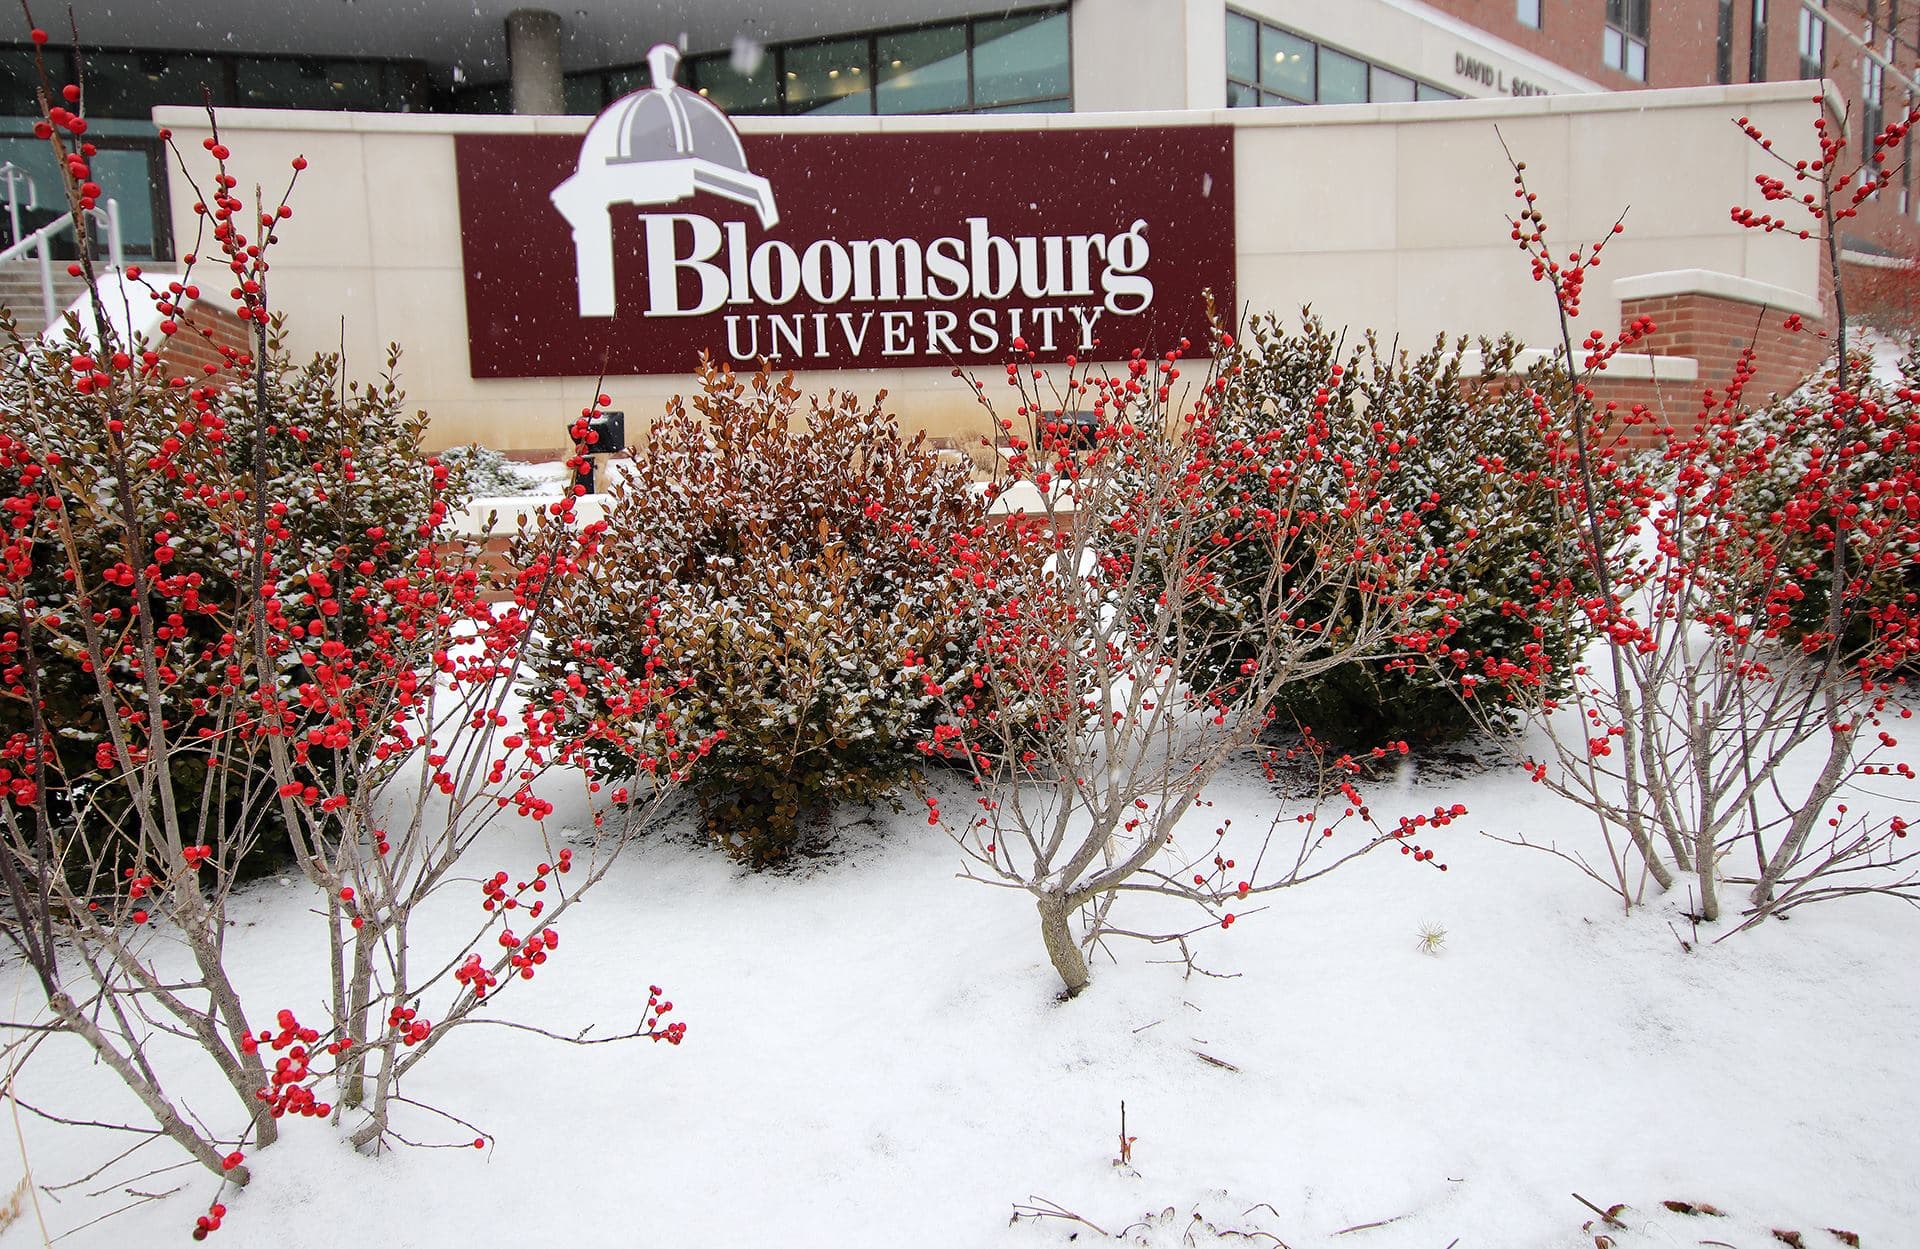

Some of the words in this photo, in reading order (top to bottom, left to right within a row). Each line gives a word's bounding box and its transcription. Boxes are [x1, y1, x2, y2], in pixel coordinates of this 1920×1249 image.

[1455, 51, 1494, 87] DAVID
[638, 212, 1154, 317] Bloomsburg
[725, 304, 1105, 361] UNIVERSITY
